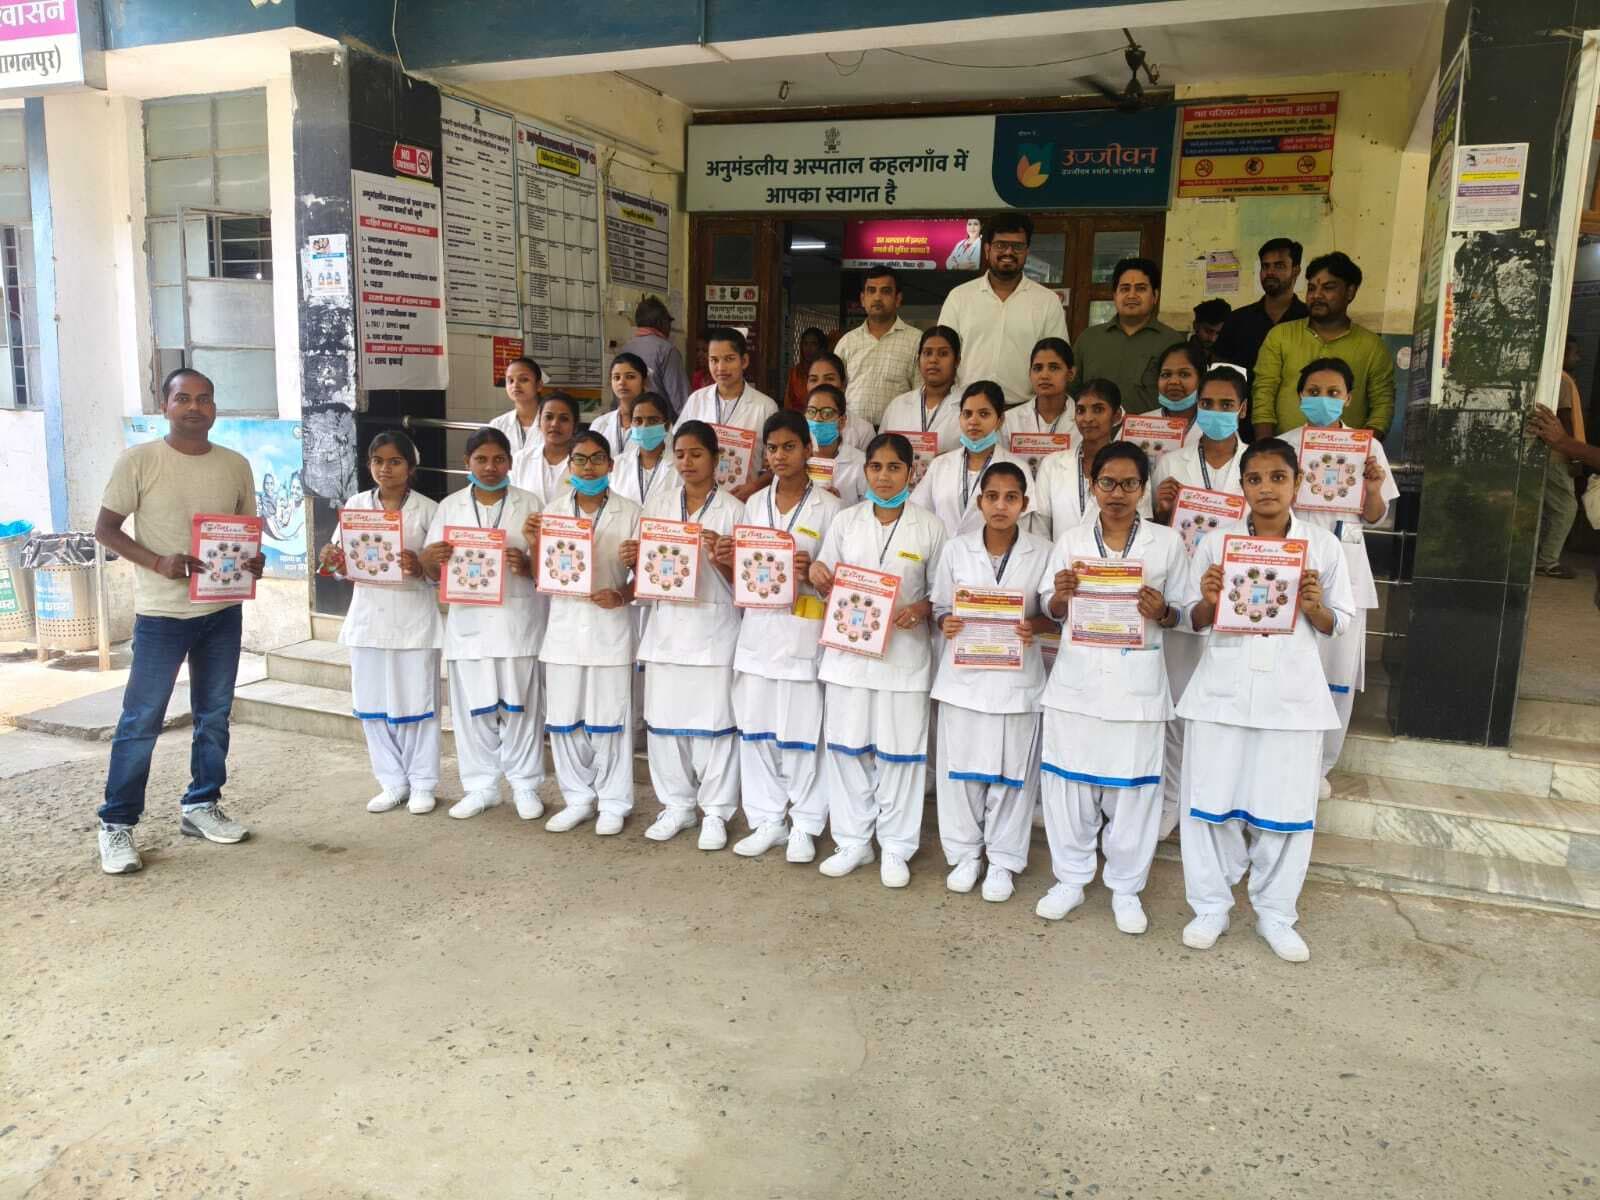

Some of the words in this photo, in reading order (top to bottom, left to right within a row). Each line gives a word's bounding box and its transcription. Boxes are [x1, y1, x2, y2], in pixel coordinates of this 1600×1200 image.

[0, 0, 66, 27] वासन
[705, 154, 789, 183] अनुमंडलीय
[793, 157, 866, 176] अस्पताल
[869, 148, 949, 174] कहलगाँव
[953, 149, 970, 172] में
[1062, 143, 1159, 166] उज्जीवन
[766, 186, 821, 204] आपका
[826, 185, 881, 204] स्वागत
[884, 179, 898, 206] है
